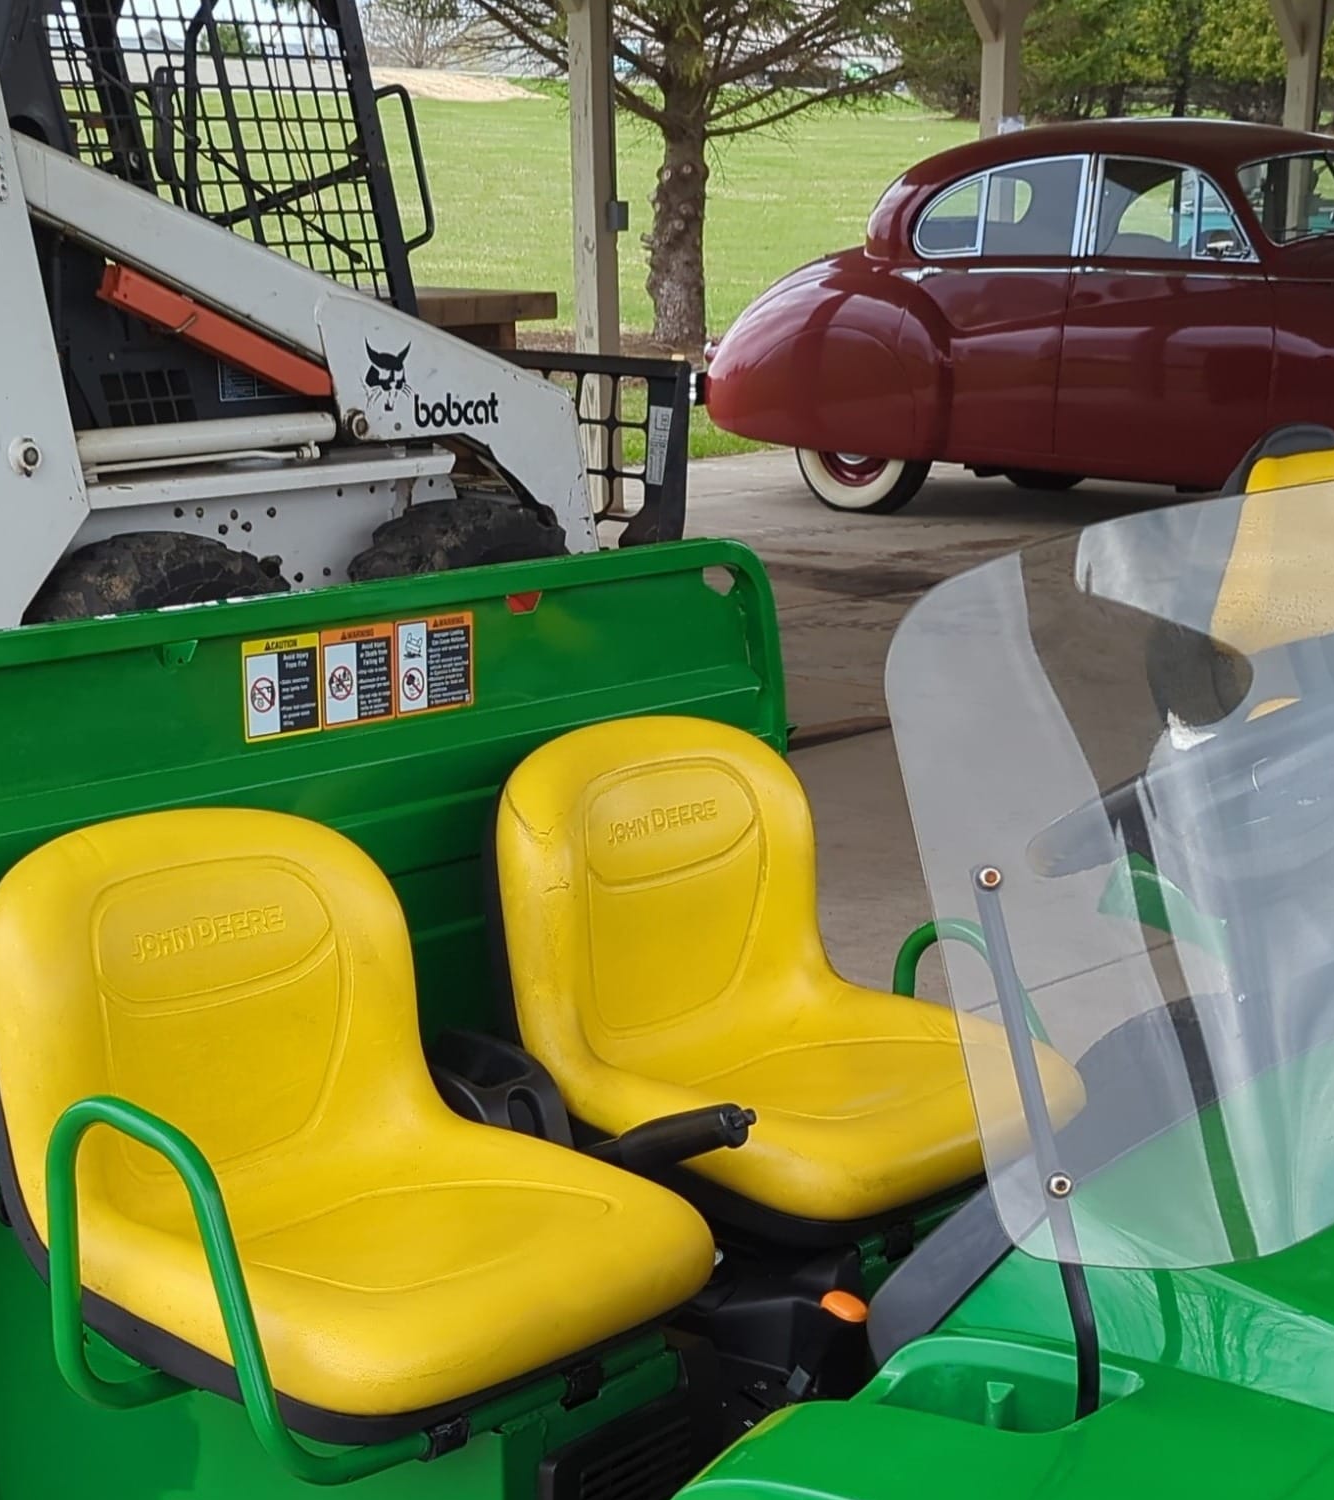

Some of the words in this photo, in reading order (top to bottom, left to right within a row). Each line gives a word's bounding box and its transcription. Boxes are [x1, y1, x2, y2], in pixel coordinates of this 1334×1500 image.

[413, 391, 499, 428] bobcat
[270, 639, 298, 650] CAUTION
[608, 815, 650, 848] JOHN
[650, 798, 717, 832] DEERE
[131, 925, 195, 964] JOHN
[193, 905, 287, 947] DEERE
